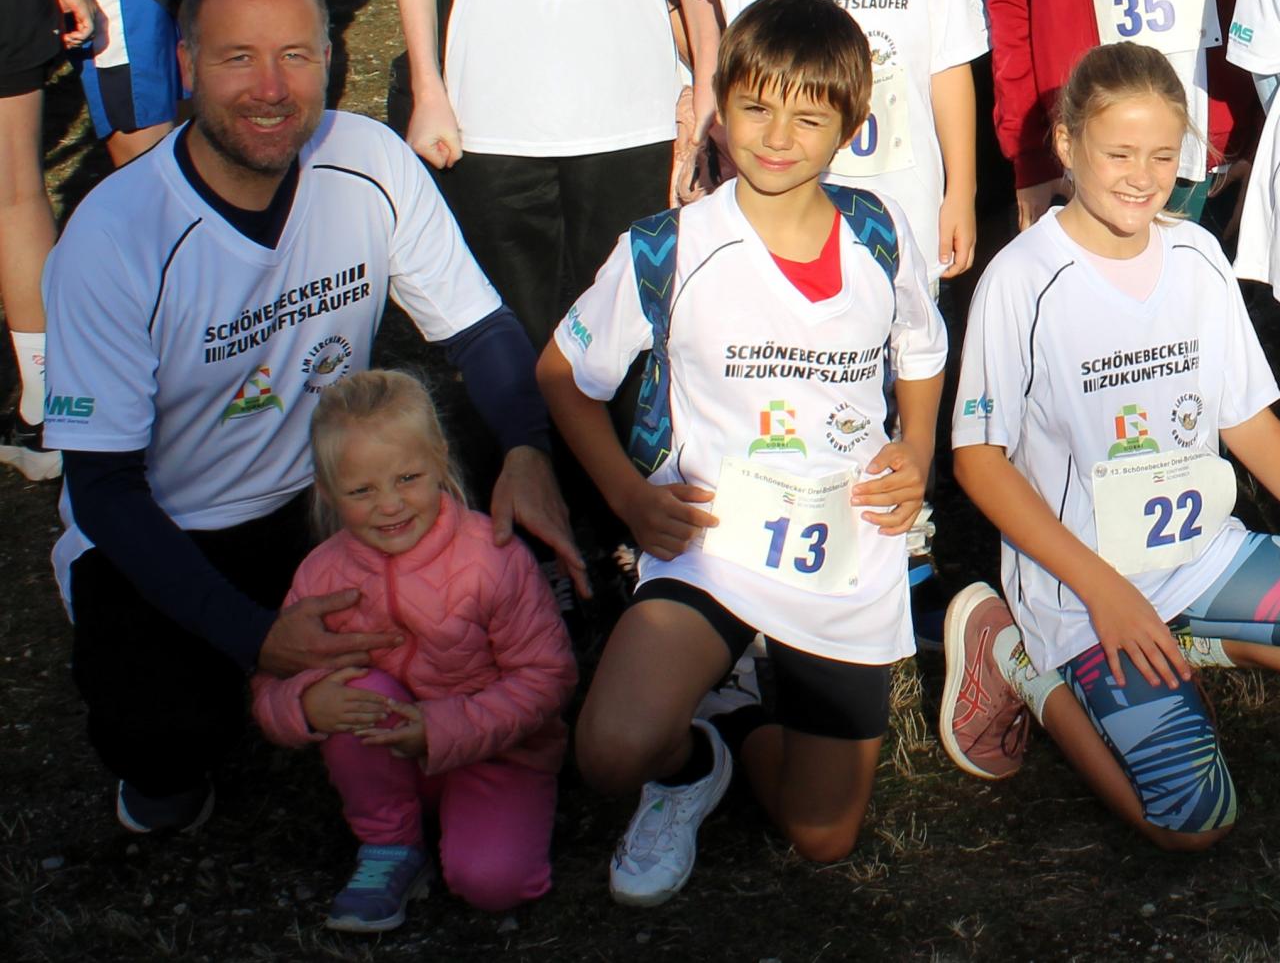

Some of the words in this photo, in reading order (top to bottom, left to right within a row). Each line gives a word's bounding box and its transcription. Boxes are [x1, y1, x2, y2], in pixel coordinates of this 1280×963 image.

[726, 341, 857, 365] SCHÖNEBECKER
[763, 516, 829, 574] 13
[1144, 489, 1203, 548] 22
